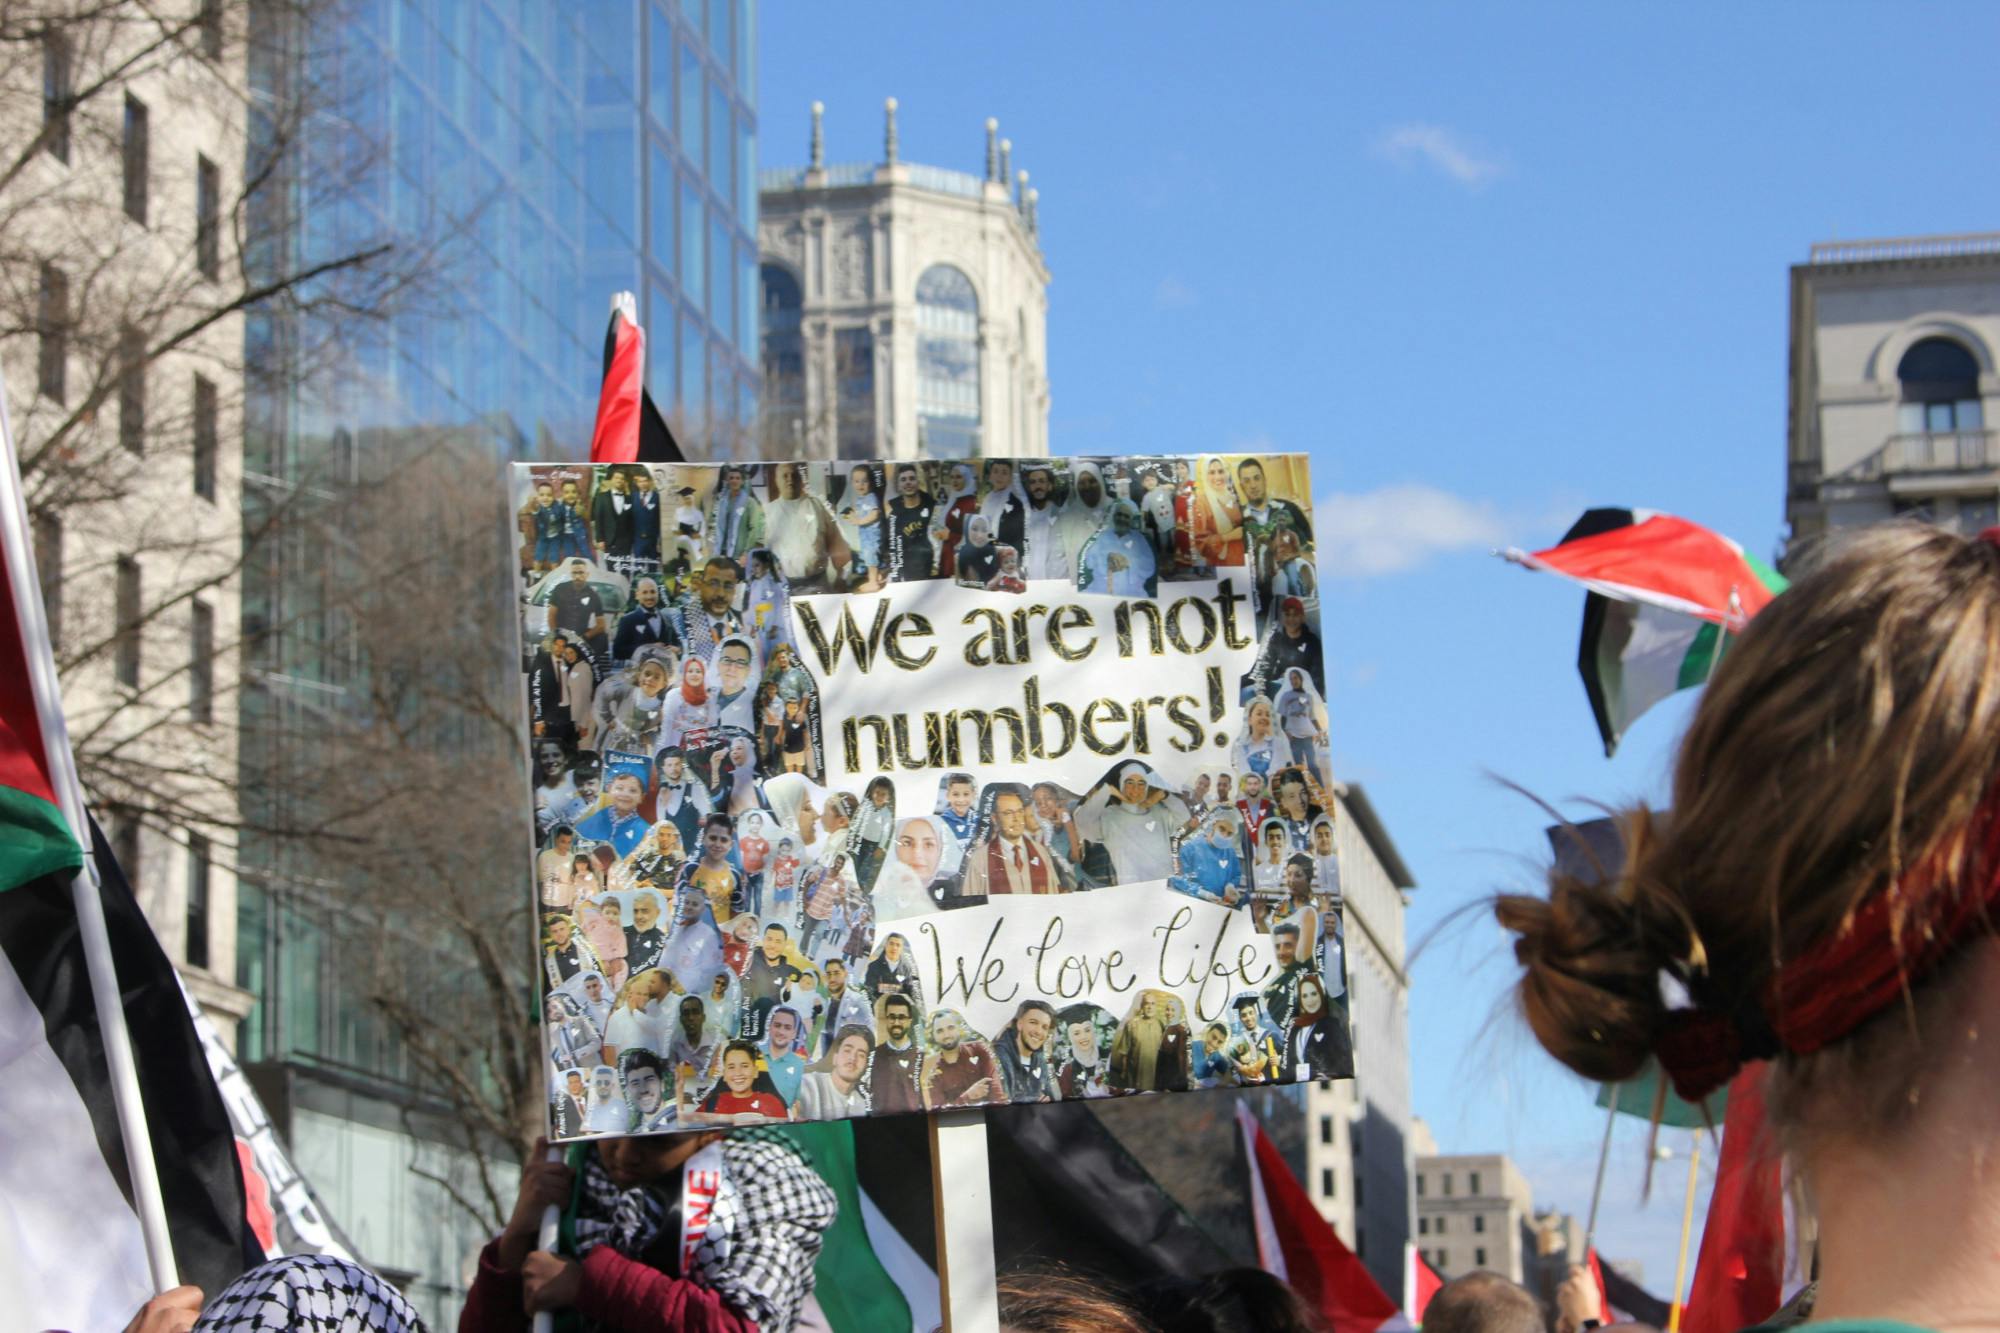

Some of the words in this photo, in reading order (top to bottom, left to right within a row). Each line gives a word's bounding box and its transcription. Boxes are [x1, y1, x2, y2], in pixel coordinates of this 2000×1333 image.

[793, 595, 938, 677] We
[961, 596, 1099, 667] are
[1114, 577, 1253, 659] not
[841, 666, 1230, 774] numbers!
[919, 916, 1020, 1007] We
